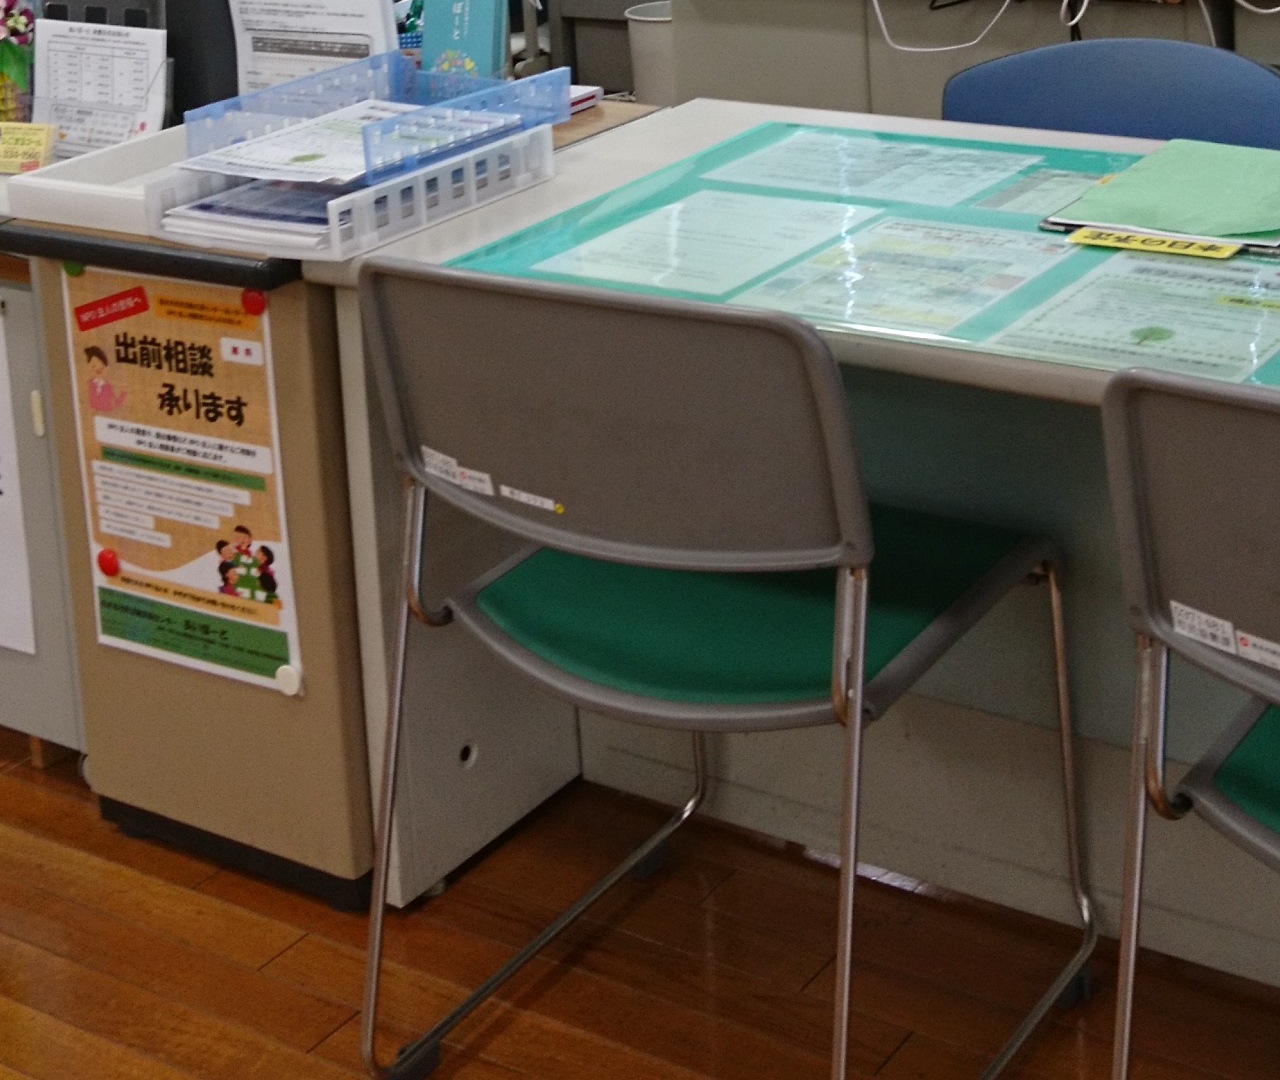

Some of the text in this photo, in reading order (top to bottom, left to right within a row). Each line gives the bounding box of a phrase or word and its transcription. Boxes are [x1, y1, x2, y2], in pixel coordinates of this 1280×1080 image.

[114, 331, 215, 379] 出前相談
[157, 381, 248, 428] 承ります
